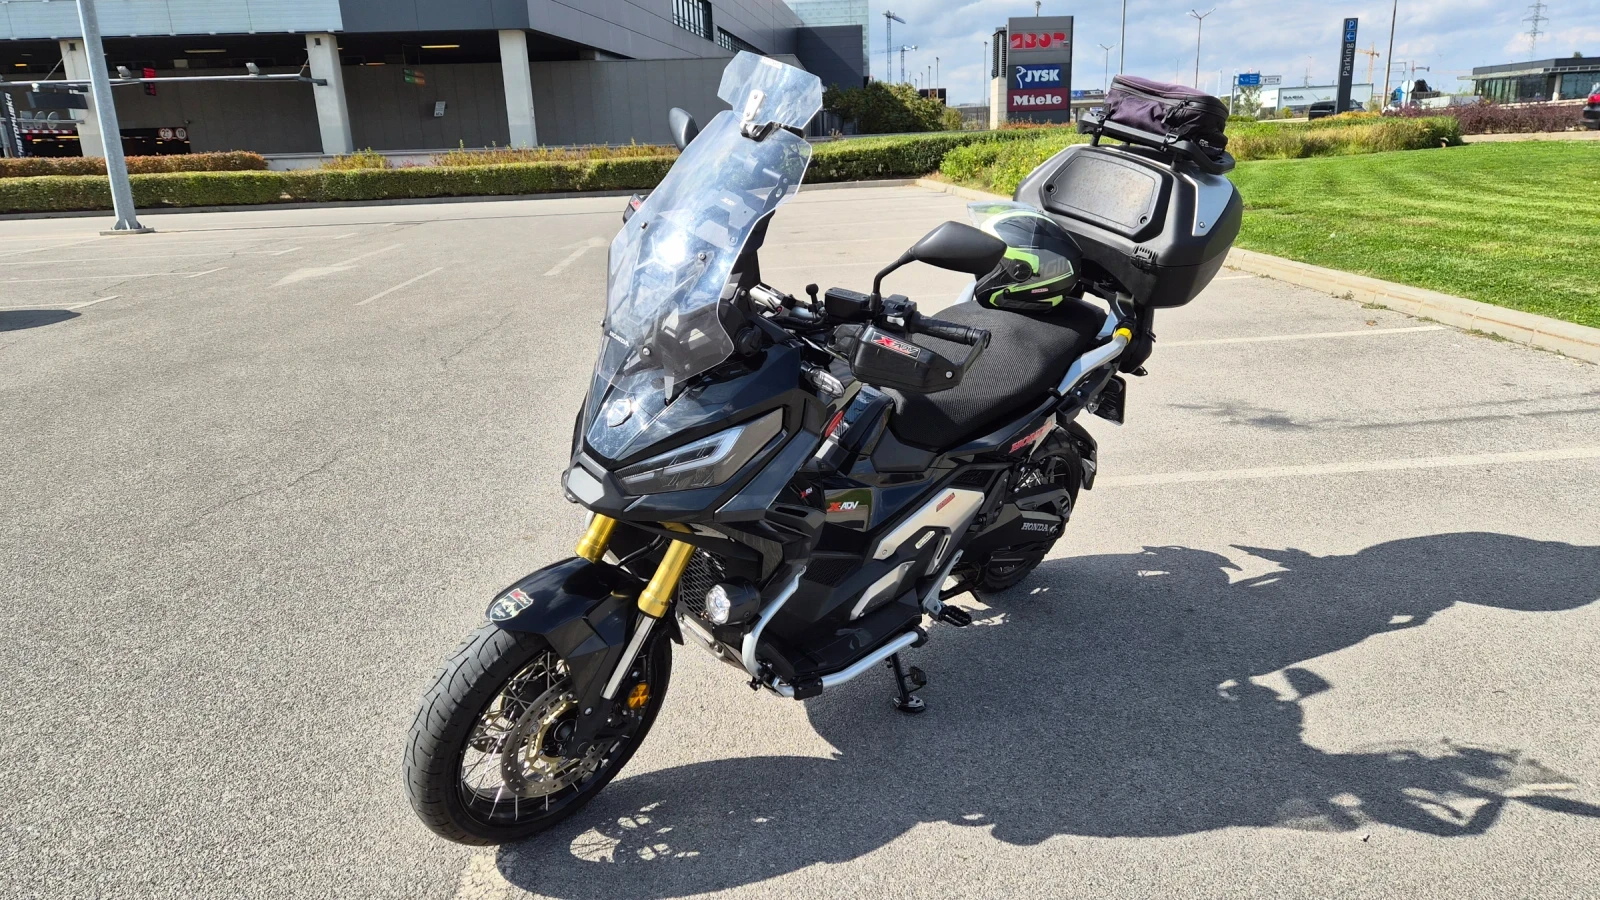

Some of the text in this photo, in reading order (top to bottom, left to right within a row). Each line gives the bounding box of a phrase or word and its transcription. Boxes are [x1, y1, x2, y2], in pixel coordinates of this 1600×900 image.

[1342, 43, 1355, 76] Parking
[1025, 69, 1060, 82] JYSK
[1013, 93, 1062, 106] Miele
[827, 501, 859, 512] X-ADV
[1021, 522, 1049, 532] HONDA
